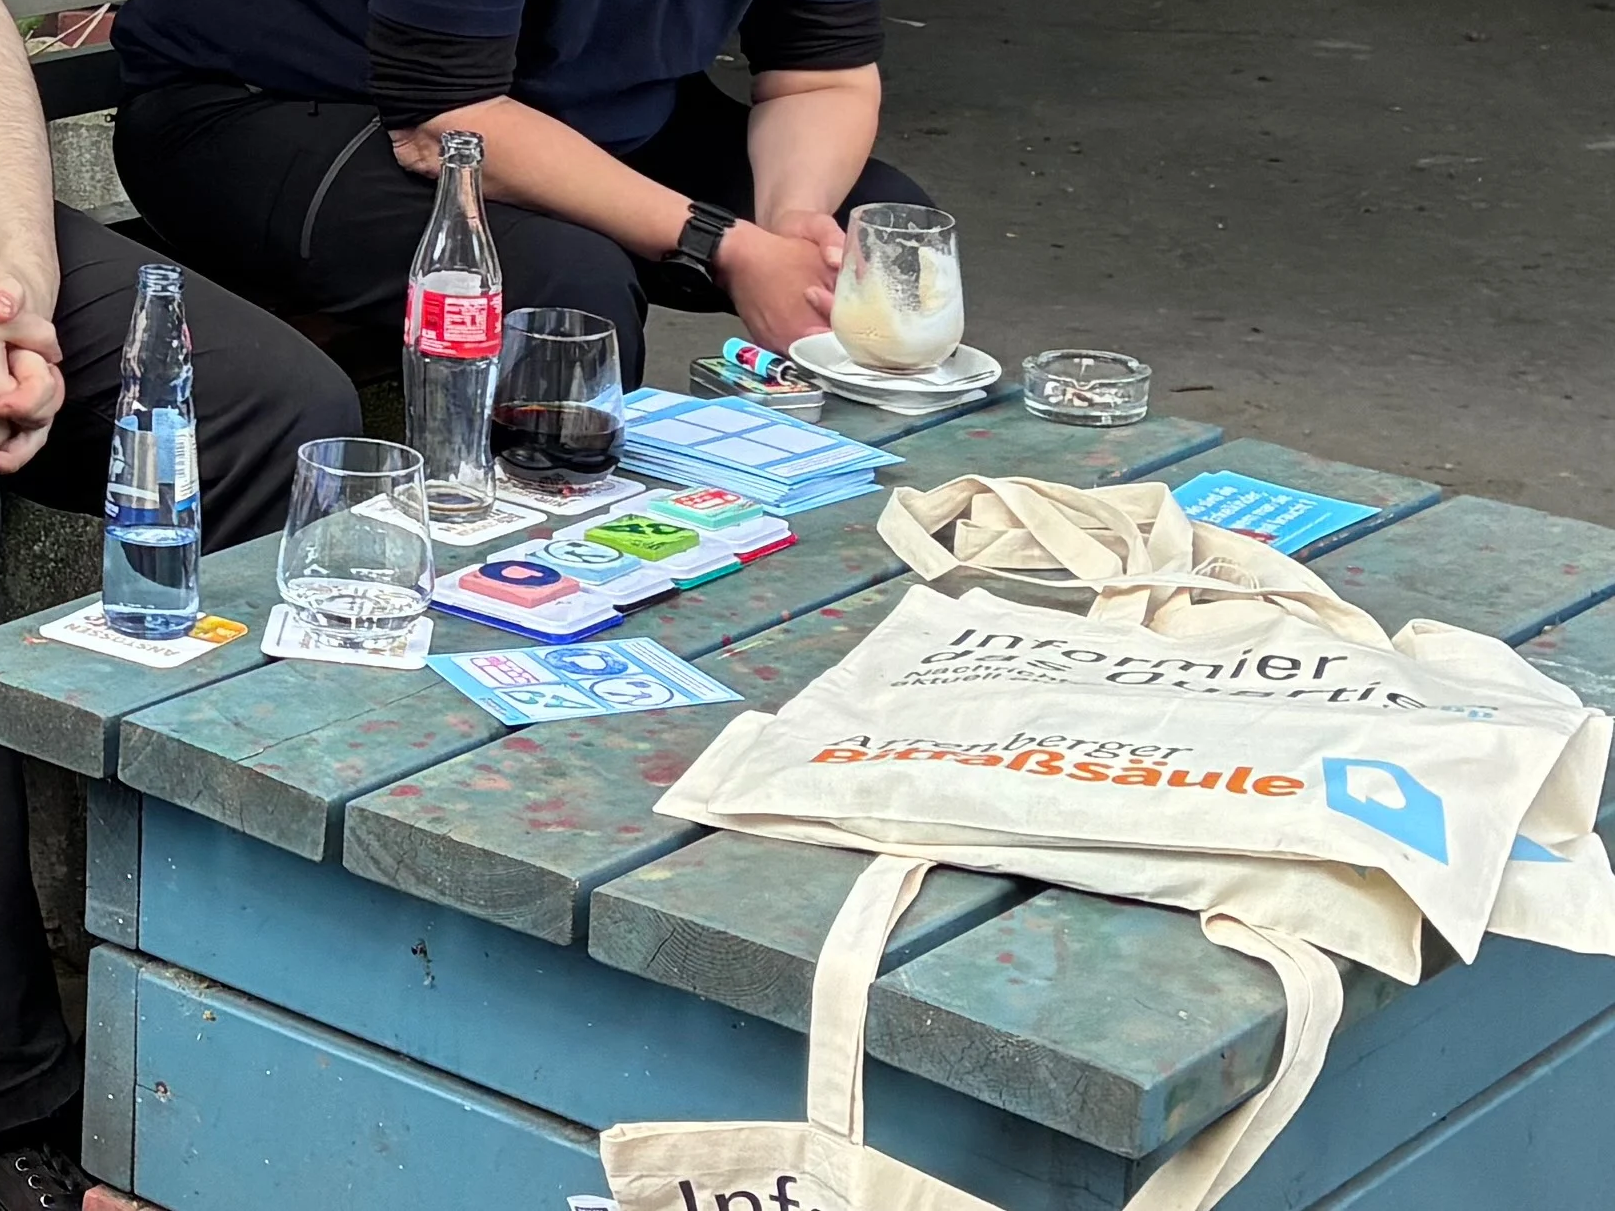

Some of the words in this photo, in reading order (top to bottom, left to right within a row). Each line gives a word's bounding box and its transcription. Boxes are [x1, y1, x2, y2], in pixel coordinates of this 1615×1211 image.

[63, 622, 181, 658] ANSTOSSEN
[949, 628, 1349, 681] Informier
[1105, 670, 1429, 710] Quartie
[824, 731, 1194, 760] Arrenberger
